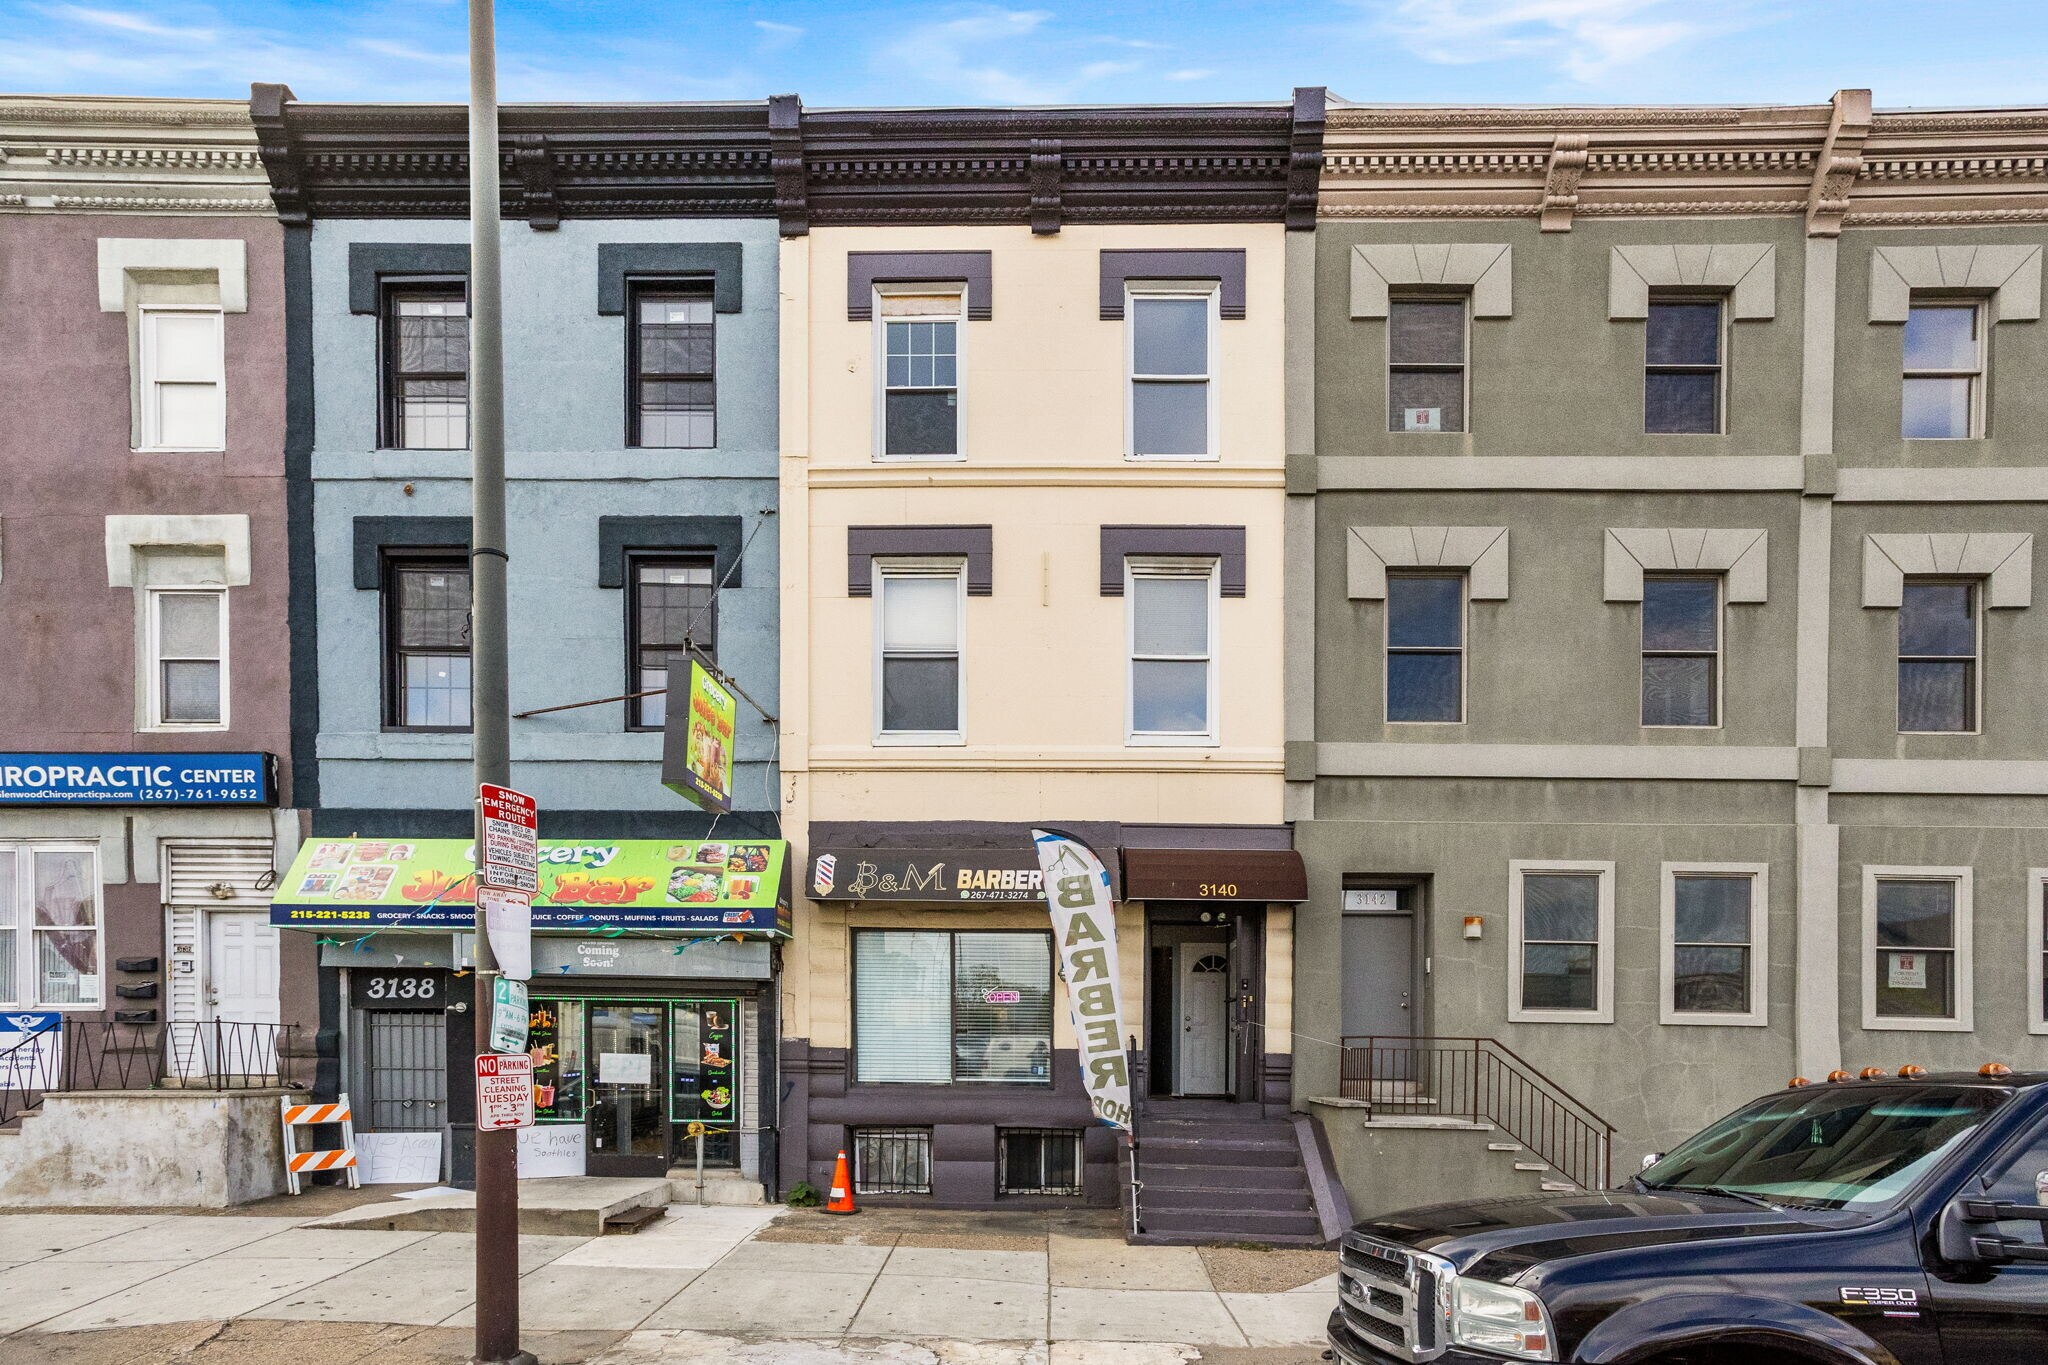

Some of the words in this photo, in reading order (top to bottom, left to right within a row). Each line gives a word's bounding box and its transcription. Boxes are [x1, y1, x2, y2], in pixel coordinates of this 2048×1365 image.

[180, 769, 256, 783] CENTER
[0, 790, 134, 800] lenwoodChiropracticpa.com
[139, 789, 257, 800] (267)-761-9652
[498, 790, 526, 806] SNOW
[484, 797, 535, 818] EMERGENCY
[498, 809, 527, 825] ROUTE
[491, 819, 509, 828] SNOW
[510, 823, 524, 832] TIRES
[488, 825, 511, 836] CHAINS
[512, 830, 534, 842] REQUIRED
[488, 846, 512, 857] VEHICLES
[513, 851, 530, 861] SUBJECT
[490, 839, 510, 849] DURING
[510, 843, 535, 855] EMERGENCY
[490, 864, 514, 873] VEHICLE
[515, 868, 536, 878] LOCATION
[956, 869, 1043, 890] BARBER
[479, 889, 491, 897] TOW
[493, 891, 508, 899] AWAY
[550, 872, 657, 905] Bar
[970, 891, 1029, 900] 267-471-3274
[1200, 884, 1237, 897] 3140
[1356, 893, 1387, 905] 3142
[290, 911, 371, 920] 215-221-5238
[376, 912, 411, 920] GROCERY
[577, 944, 619, 958] Coming
[583, 956, 614, 968] Soon!
[366, 977, 435, 999] 3138
[498, 981, 507, 1000] 2
[988, 992, 1018, 1003] OPEN
[479, 1059, 497, 1074] NO
[499, 1060, 529, 1070] PARKING
[490, 1077, 520, 1085] STREET
[484, 1085, 527, 1094] CLEANING
[482, 1093, 529, 1104] TUESDAY
[549, 1130, 582, 1147] have
